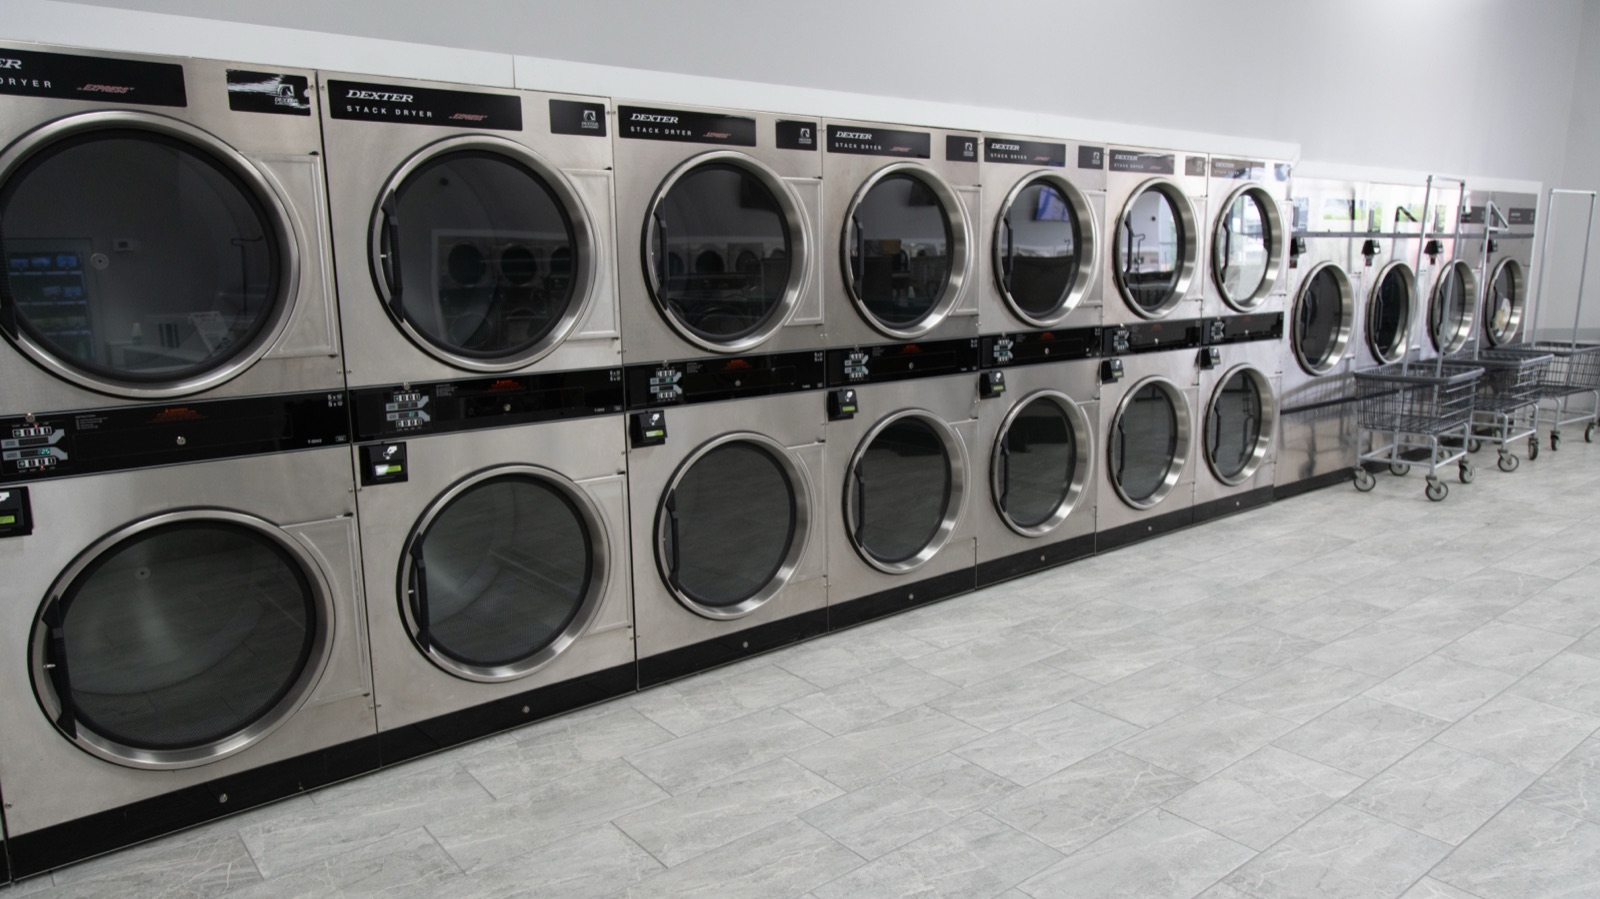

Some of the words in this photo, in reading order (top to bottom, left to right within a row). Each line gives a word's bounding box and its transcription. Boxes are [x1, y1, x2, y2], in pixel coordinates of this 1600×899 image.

[83, 84, 129, 94] EXPRESS
[346, 89, 414, 103] DEXTER
[346, 105, 387, 115] STACK
[395, 109, 433, 118] DRYER
[630, 113, 679, 124] DEXTER
[630, 126, 659, 134] STACK
[665, 128, 692, 136] DRYER
[835, 131, 872, 140] DEXTER
[991, 142, 1020, 151] DEXTER
